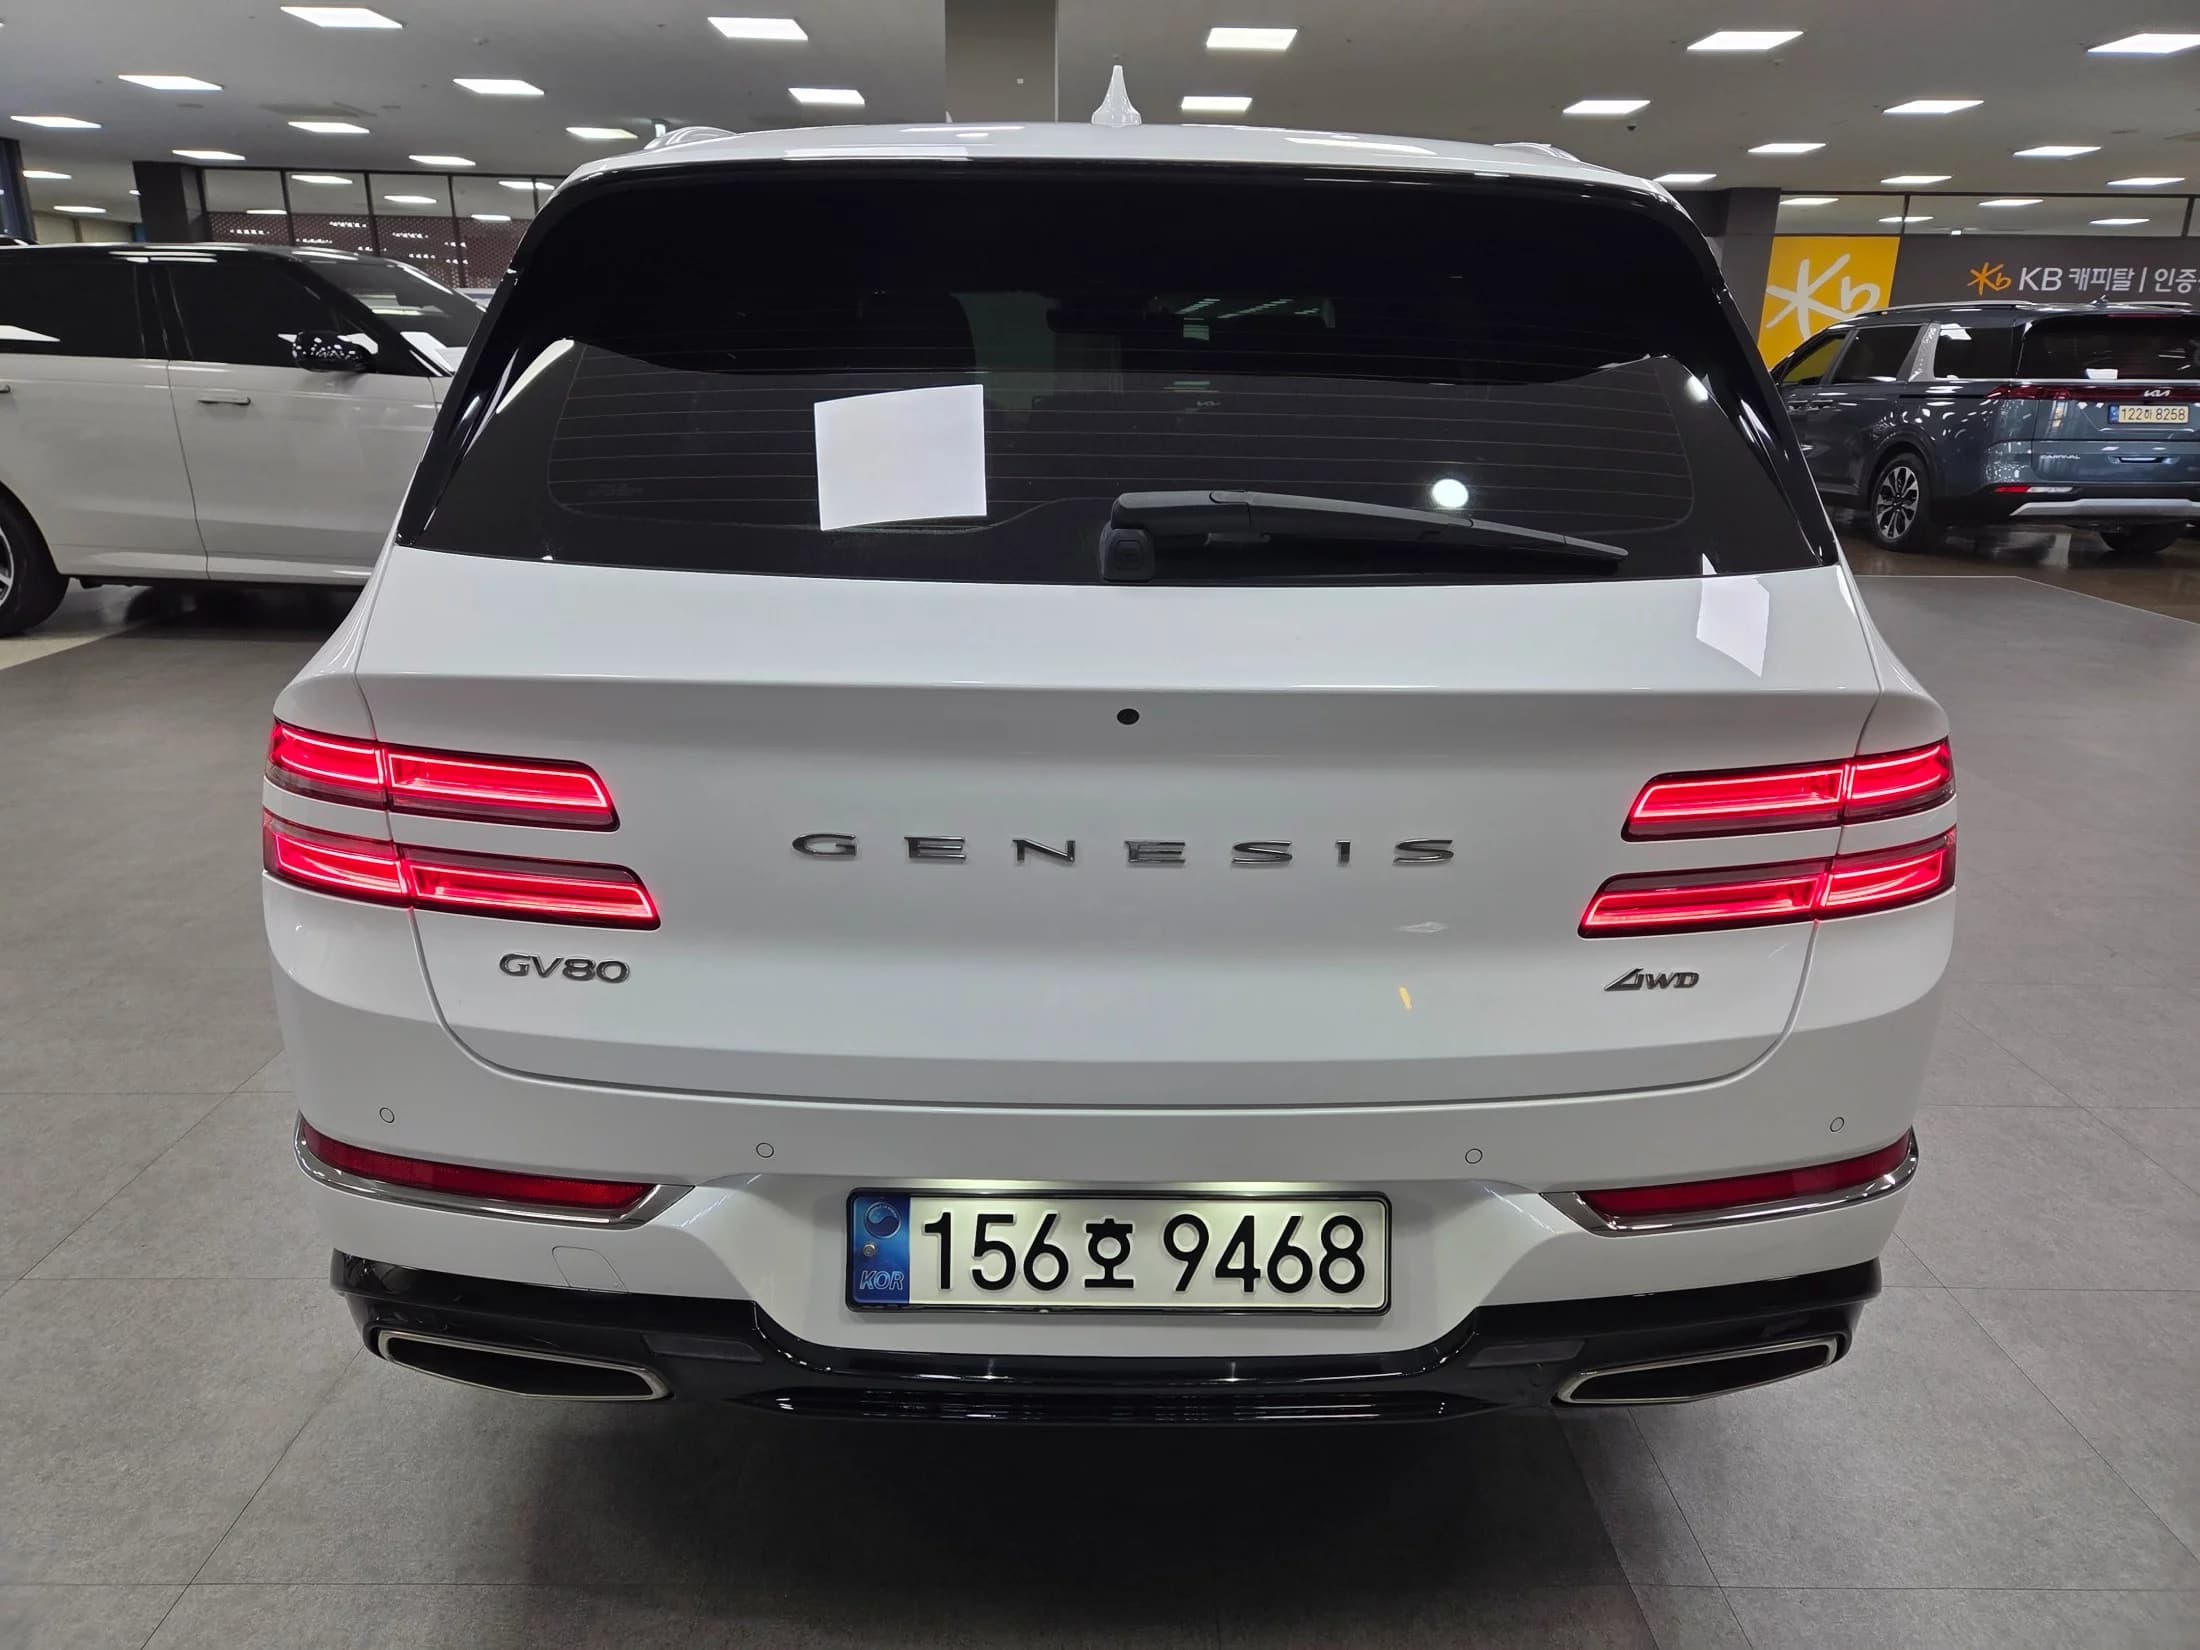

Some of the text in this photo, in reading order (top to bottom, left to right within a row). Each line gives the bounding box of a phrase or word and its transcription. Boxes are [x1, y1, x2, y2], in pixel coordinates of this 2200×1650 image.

[2018, 267, 2063, 292] KB
[2068, 267, 2135, 292] 캐피탈
[2154, 268, 2200, 294] 인증
[2155, 407, 2186, 421] 8258
[792, 833, 1454, 866] GENESIS
[498, 952, 631, 984] GV80
[923, 1210, 1367, 1294] 156호 9468
[859, 1269, 905, 1291] KOR
